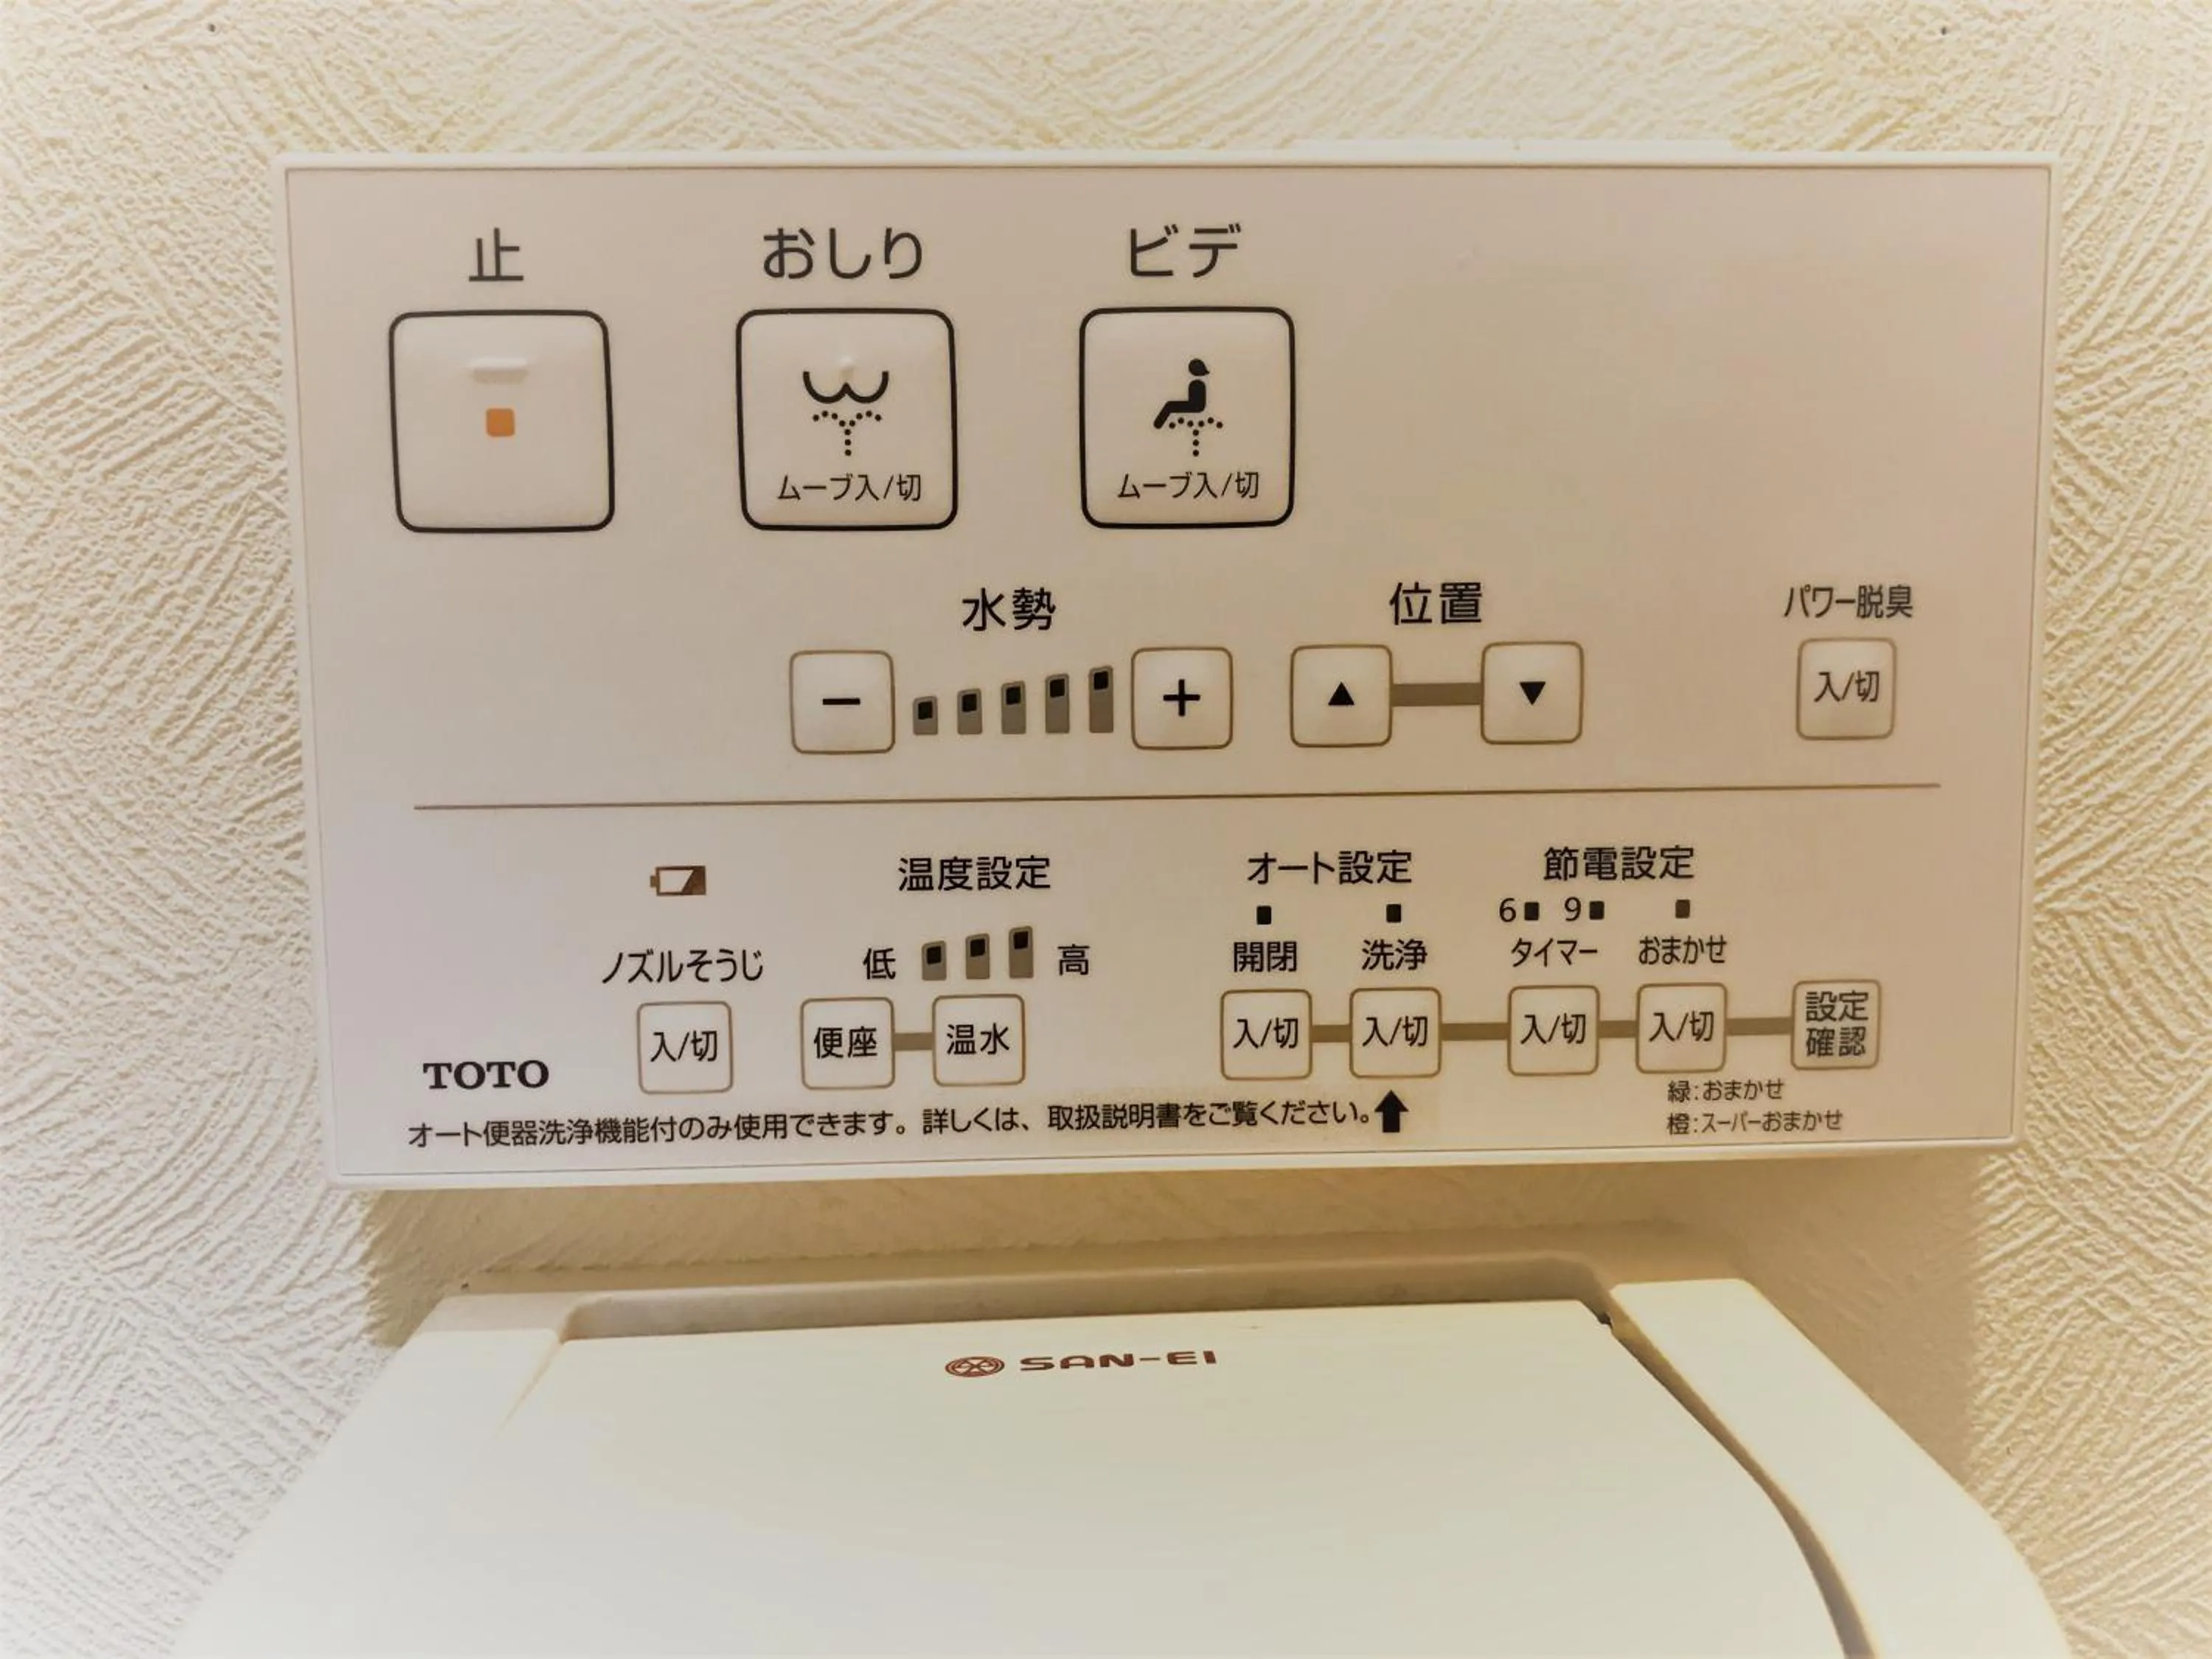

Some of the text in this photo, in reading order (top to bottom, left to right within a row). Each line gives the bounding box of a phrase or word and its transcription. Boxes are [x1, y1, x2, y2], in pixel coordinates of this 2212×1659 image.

[468, 227, 524, 282] 止
[763, 227, 922, 279] おしり
[1130, 223, 1242, 279] ビデ
[777, 473, 922, 502] ムーブ入/切
[1117, 471, 1259, 499] ムーブ入/切
[961, 586, 1057, 632] 水勢
[1389, 581, 1483, 626] 位置
[1784, 583, 1913, 619] パワー脱臭
[1813, 670, 1880, 703] 入/切
[898, 855, 1051, 891] 温度設定
[1247, 849, 1412, 886] オート設定
[1543, 844, 1694, 882] 節電設定
[1499, 896, 1582, 923] 6 9
[602, 948, 763, 984] ノズルそうじ
[862, 947, 897, 980] 低
[1057, 943, 1091, 976] 高
[1234, 941, 1298, 973] 開閉
[1361, 938, 1428, 971] 洗浄
[1511, 937, 1598, 968] タイマー
[1638, 934, 1728, 965] おまかせ
[1805, 990, 1869, 1023] 設定
[813, 1026, 878, 1060] 便座
[946, 1022, 1010, 1055] 温水
[1233, 1017, 1298, 1049] 入/切
[1362, 1015, 1428, 1048] 入/切
[1520, 1012, 1586, 1045] 入/切
[1649, 1010, 1714, 1043] 入/切
[1806, 1026, 1866, 1058] 確認
[650, 1030, 717, 1062] 入/切
[422, 1060, 549, 1090] TOTO
[1667, 1078, 1784, 1104] 緑:おまかせ
[1020, 1350, 1217, 1371] SAN-EI
